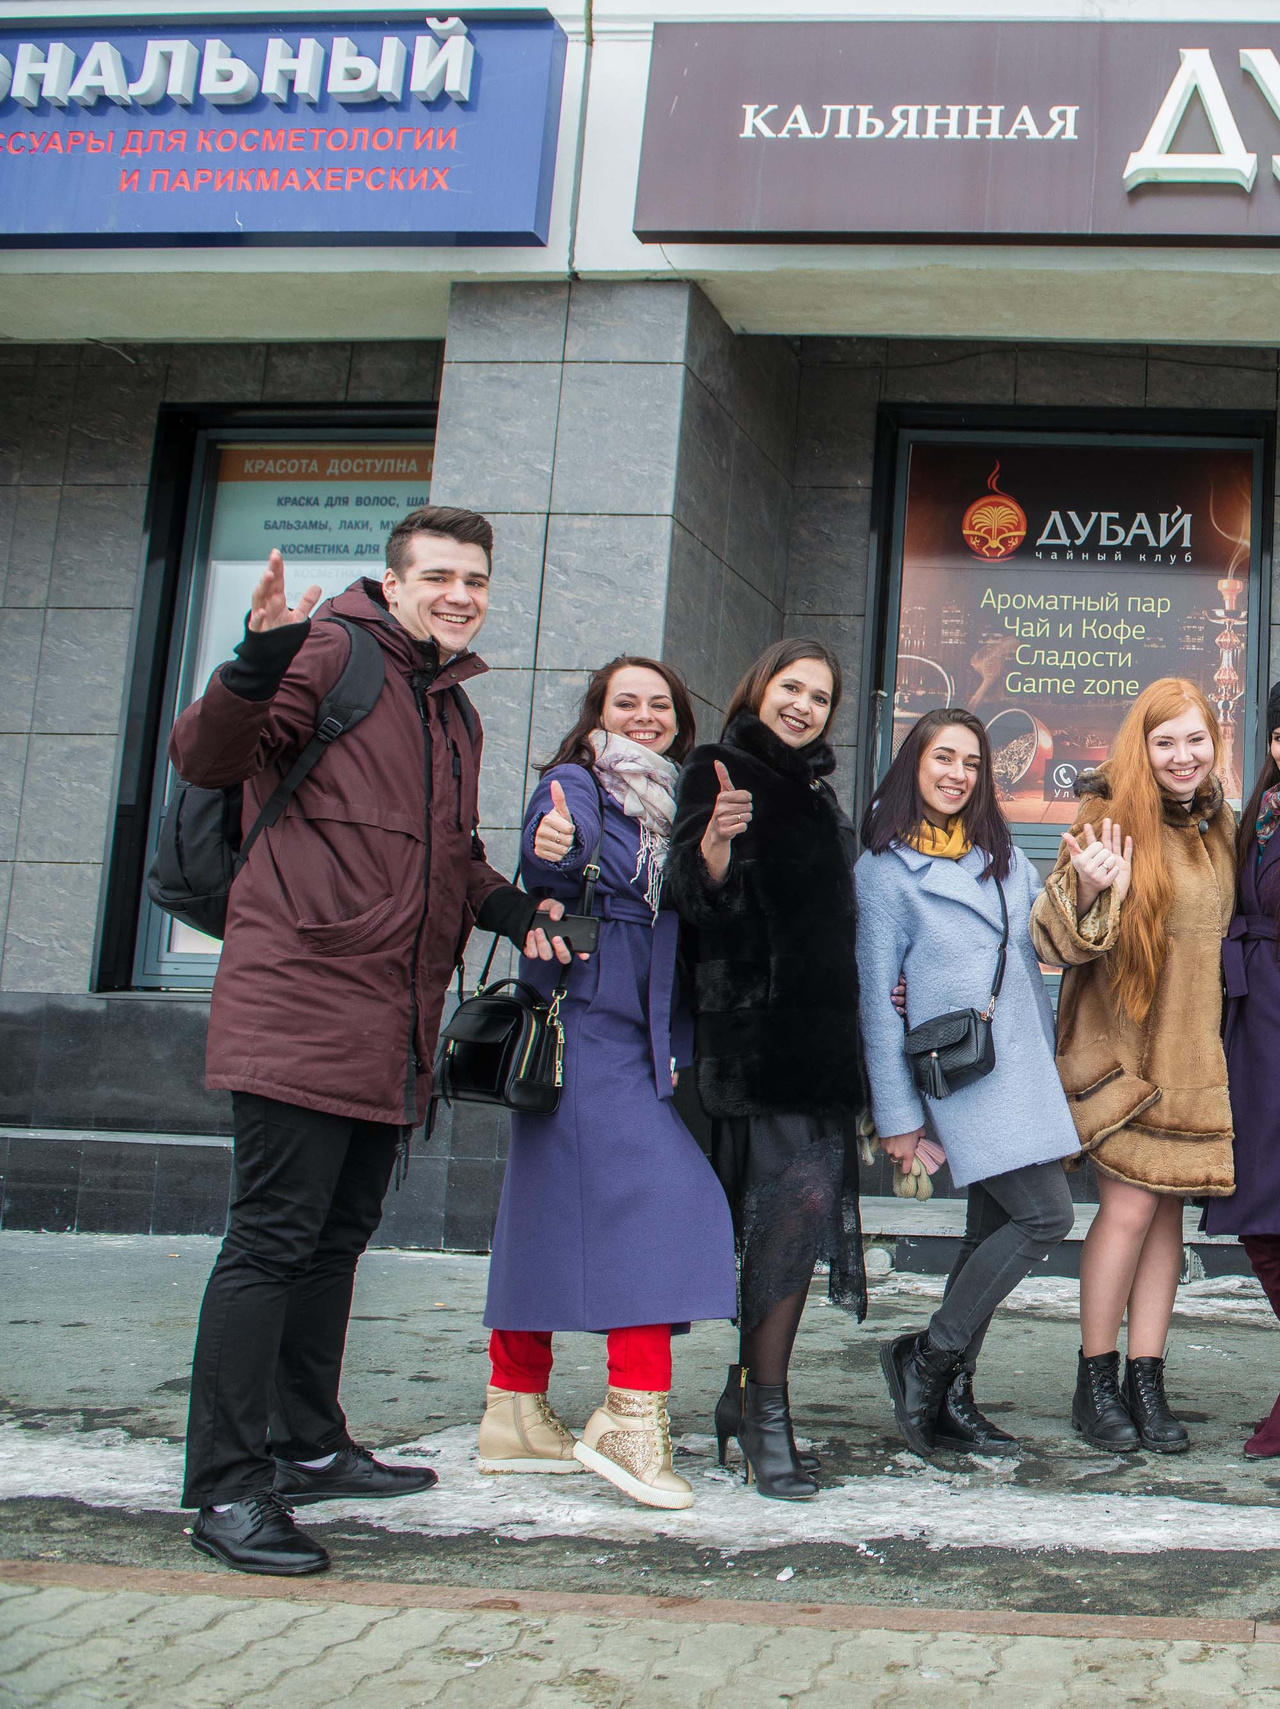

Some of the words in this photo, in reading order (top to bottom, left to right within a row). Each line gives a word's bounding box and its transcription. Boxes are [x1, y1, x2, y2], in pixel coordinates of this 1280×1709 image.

[0, 16, 474, 107] НАЛЬНЫЙ
[739, 104, 1080, 140] КАЛЬЯННАЯ
[0, 130, 114, 154] СУАРЫ
[120, 129, 188, 158] ДЛЯ
[197, 127, 458, 152] КОСМЕТОЛОГИИ
[119, 169, 140, 192] И
[149, 167, 450, 192] ПАРИКМАХЕРСКИХ
[244, 459, 319, 474] КРАСОТА
[326, 459, 418, 476] ДОСТУПНА
[277, 496, 320, 507] КРАСКА
[324, 496, 349, 508] ДЛЯ
[355, 496, 399, 508] ВОЛОС,
[264, 520, 332, 532] БАЛЬЗАМЫ,
[338, 520, 373, 532] ЛАКИ,
[1036, 505, 1193, 548] ДУБАЙ
[281, 544, 350, 555] КОСМЕТИКА
[354, 544, 380, 556] ДЛЯ
[1035, 551, 1122, 562] чайный
[1139, 552, 1192, 565] клуб
[980, 588, 1119, 614] Ароматный
[1127, 596, 1171, 618] пар
[1004, 616, 1050, 638] Чай
[1059, 623, 1073, 639] и
[1081, 618, 1146, 645] Кофе
[1015, 644, 1132, 669] Сладости
[1005, 672, 1075, 694] Game
[1083, 678, 1140, 696] zone
